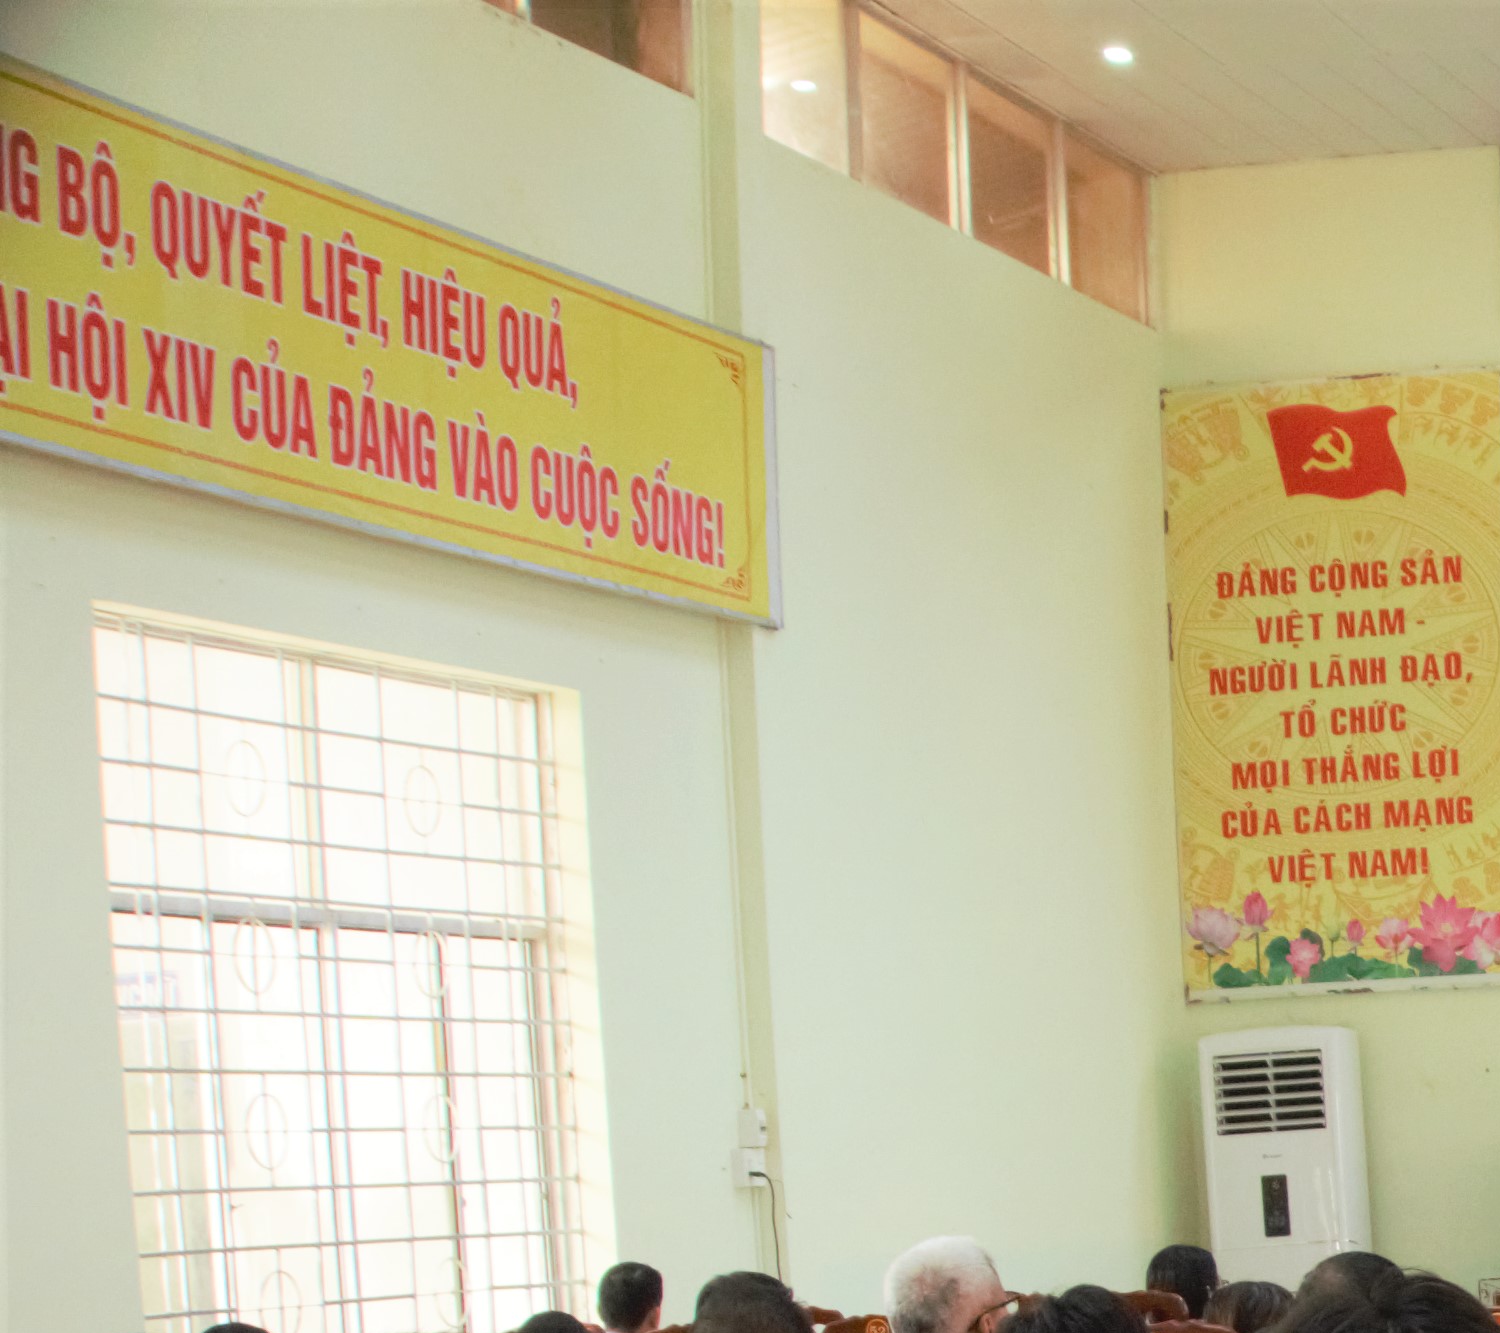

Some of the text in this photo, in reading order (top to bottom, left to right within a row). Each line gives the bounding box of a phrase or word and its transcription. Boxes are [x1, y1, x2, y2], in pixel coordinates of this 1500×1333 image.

[57, 142, 135, 267] BỘ,
[152, 182, 287, 304] QUYẾT
[302, 233, 389, 347] LIỆT,
[403, 269, 486, 377] HIỆU
[499, 299, 577, 406] QUẢ,
[48, 294, 128, 422] HỘI
[144, 330, 215, 429] XIV
[232, 340, 317, 458] CỦA
[329, 368, 437, 492] ĐẢNG
[449, 414, 518, 511] VÀO
[531, 446, 619, 547] CUỘC
[631, 463, 724, 572] SỐNG!
[1216, 549, 1463, 600] ĐẢNG CỘNG SẢN
[1256, 609, 1324, 650] VIỆT
[1336, 607, 1405, 638] NAM
[1209, 651, 1473, 696] NGƯỜI LÃNH ĐẠO,
[1280, 699, 1406, 740] TỔ CHỨC
[1231, 745, 1459, 797] MỌI THẮNG LỢI
[1221, 796, 1474, 839] CỦA CÁCH MẠNG
[1268, 847, 1429, 889] VIỆT NAM!
